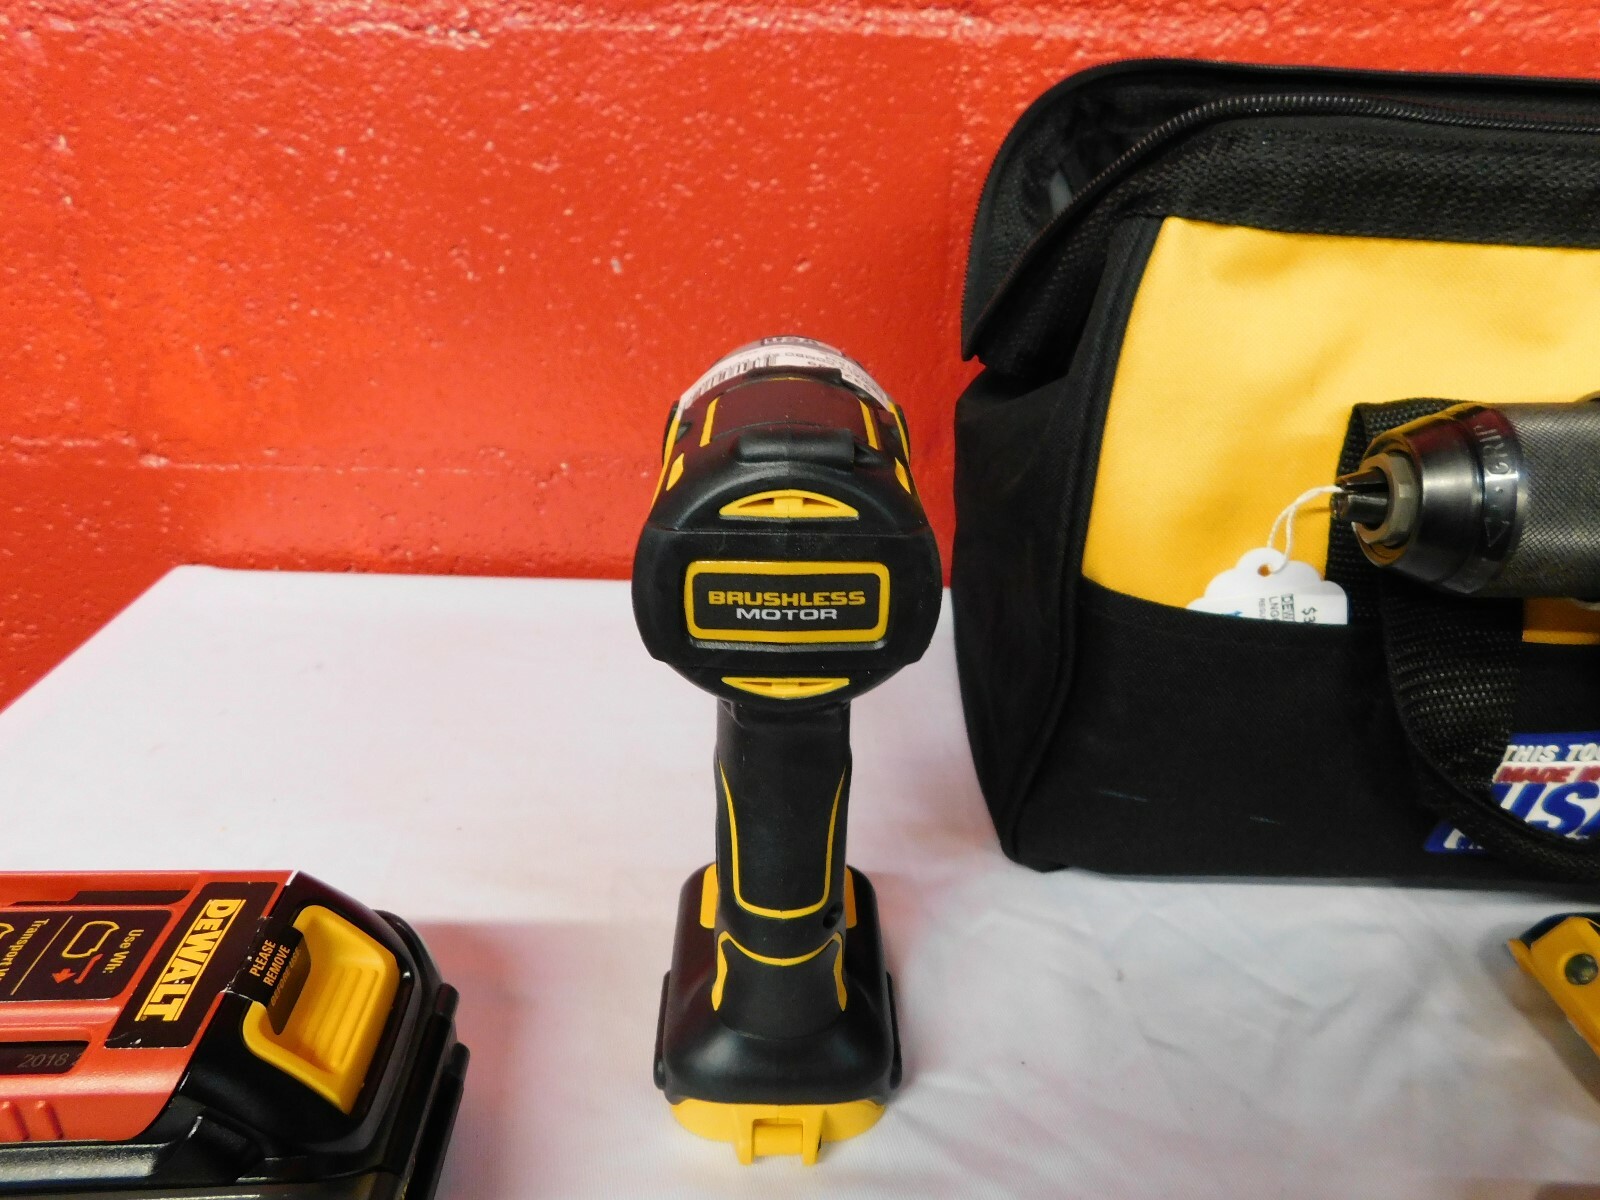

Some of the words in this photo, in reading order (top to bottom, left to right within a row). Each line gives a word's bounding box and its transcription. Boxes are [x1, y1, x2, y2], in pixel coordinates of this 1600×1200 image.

[708, 590, 866, 607] BRUSHLESS
[736, 608, 838, 621] MOTOR
[1502, 745, 1560, 762] THIS
[1566, 743, 1600, 762] TO
[1492, 781, 1600, 838] US
[119, 929, 144, 949] Use
[137, 899, 244, 1021] DEWALT
[249, 939, 276, 977] PLEASE
[262, 944, 291, 987] REMOVE
[17, 1052, 70, 1069] 2018
